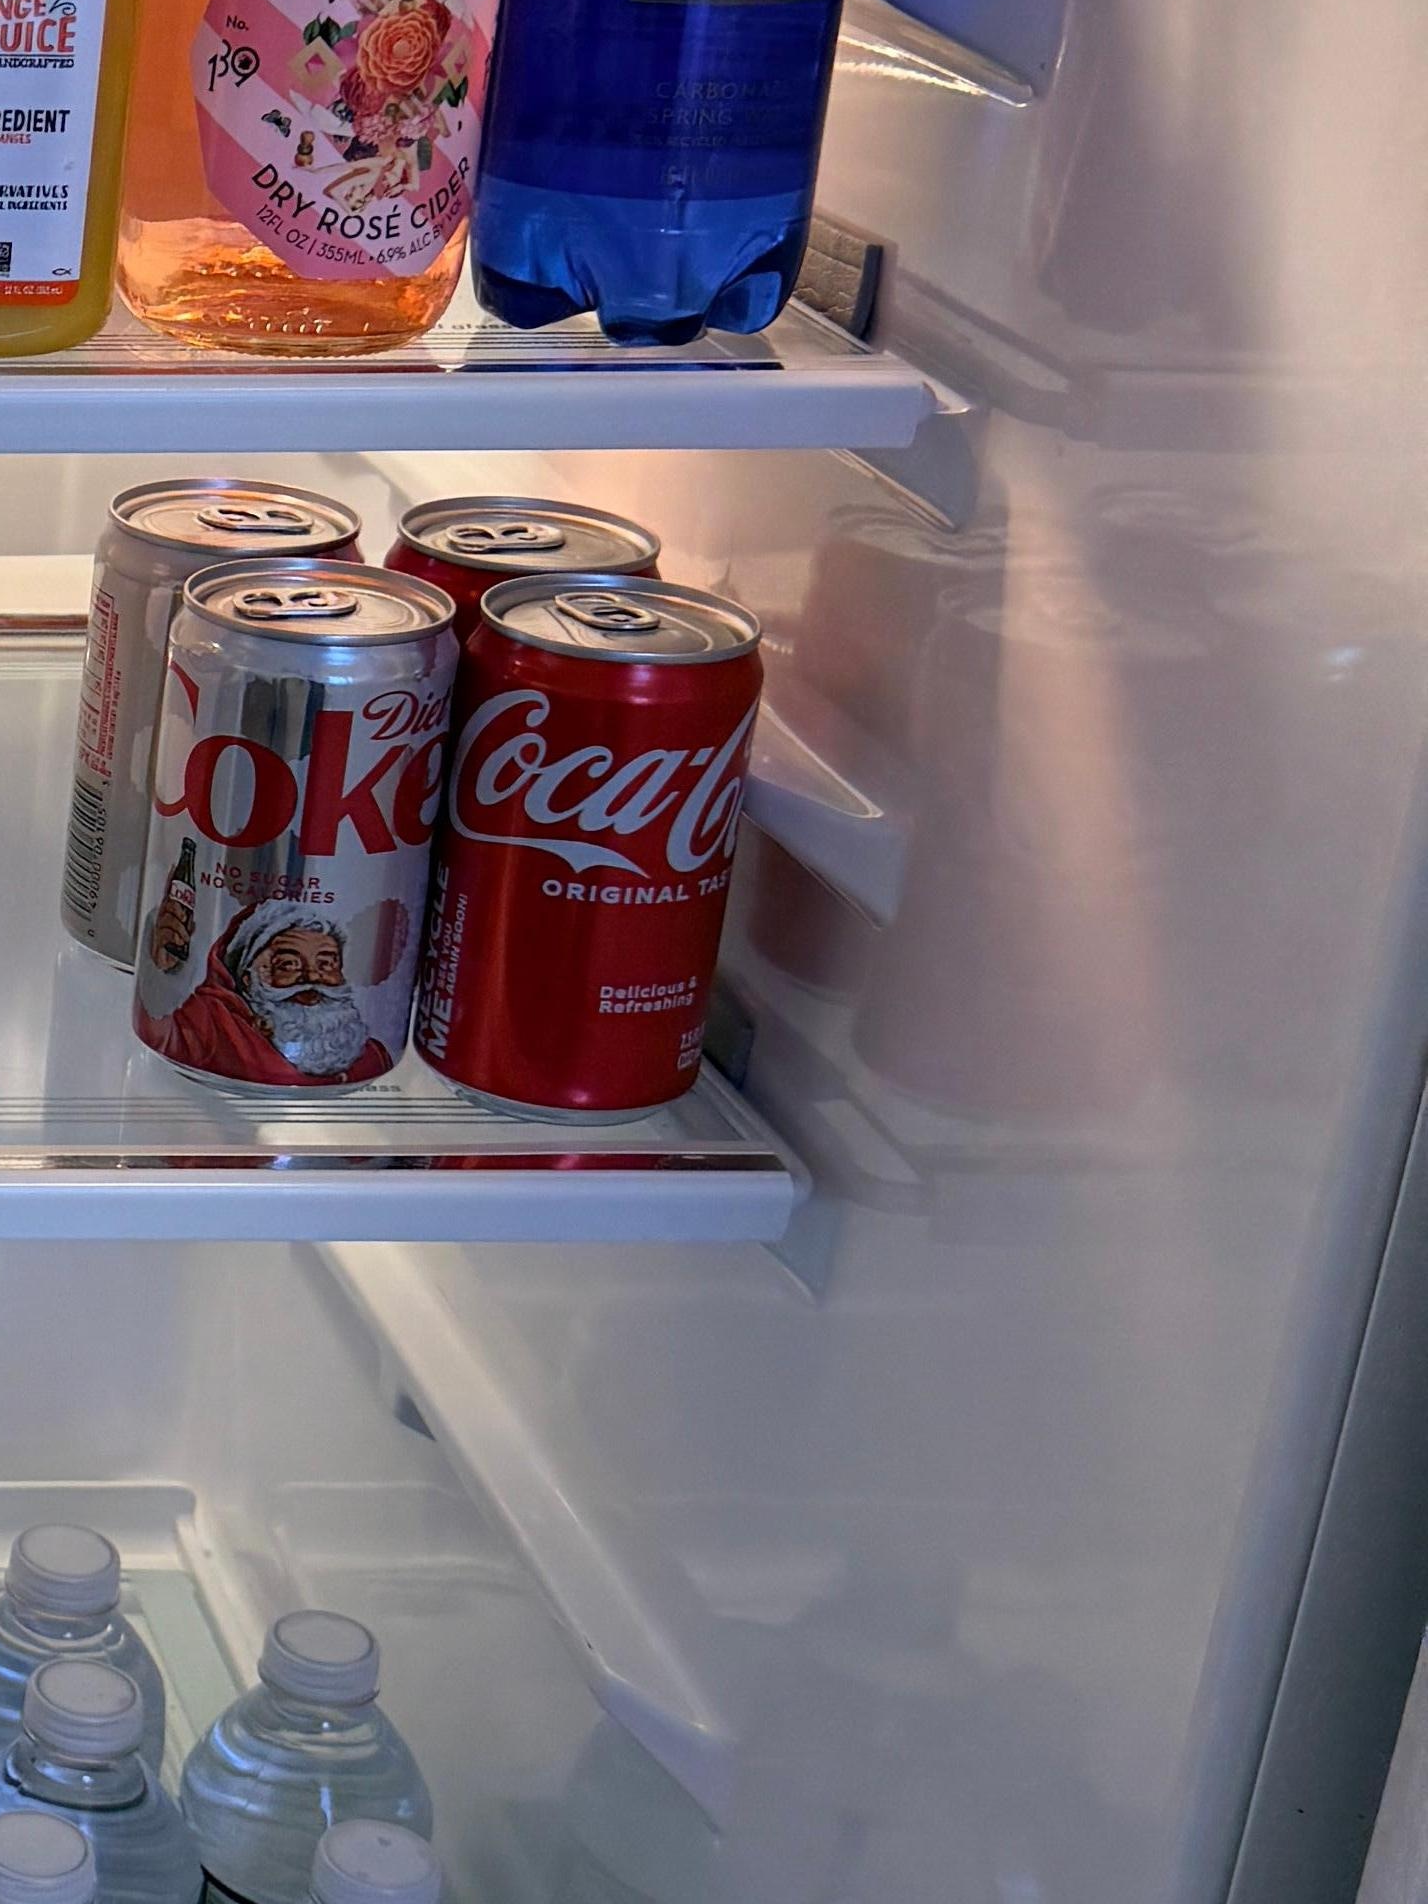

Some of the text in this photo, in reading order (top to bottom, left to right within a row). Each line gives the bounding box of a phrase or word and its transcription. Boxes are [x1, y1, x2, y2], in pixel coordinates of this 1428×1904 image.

[226, 14, 250, 32] No.
[251, 156, 471, 241] DRY ROSÉ CIDER
[362, 689, 452, 742] Diet
[200, 872, 225, 889] NO
[215, 862, 320, 889] NO SUGAR
[542, 879, 690, 904] ORIGINAL
[446, 893, 468, 995] AGAIN SOON!
[599, 981, 684, 1000] Delicious
[599, 992, 694, 1014] Refreshing
[427, 990, 453, 1060] ME
